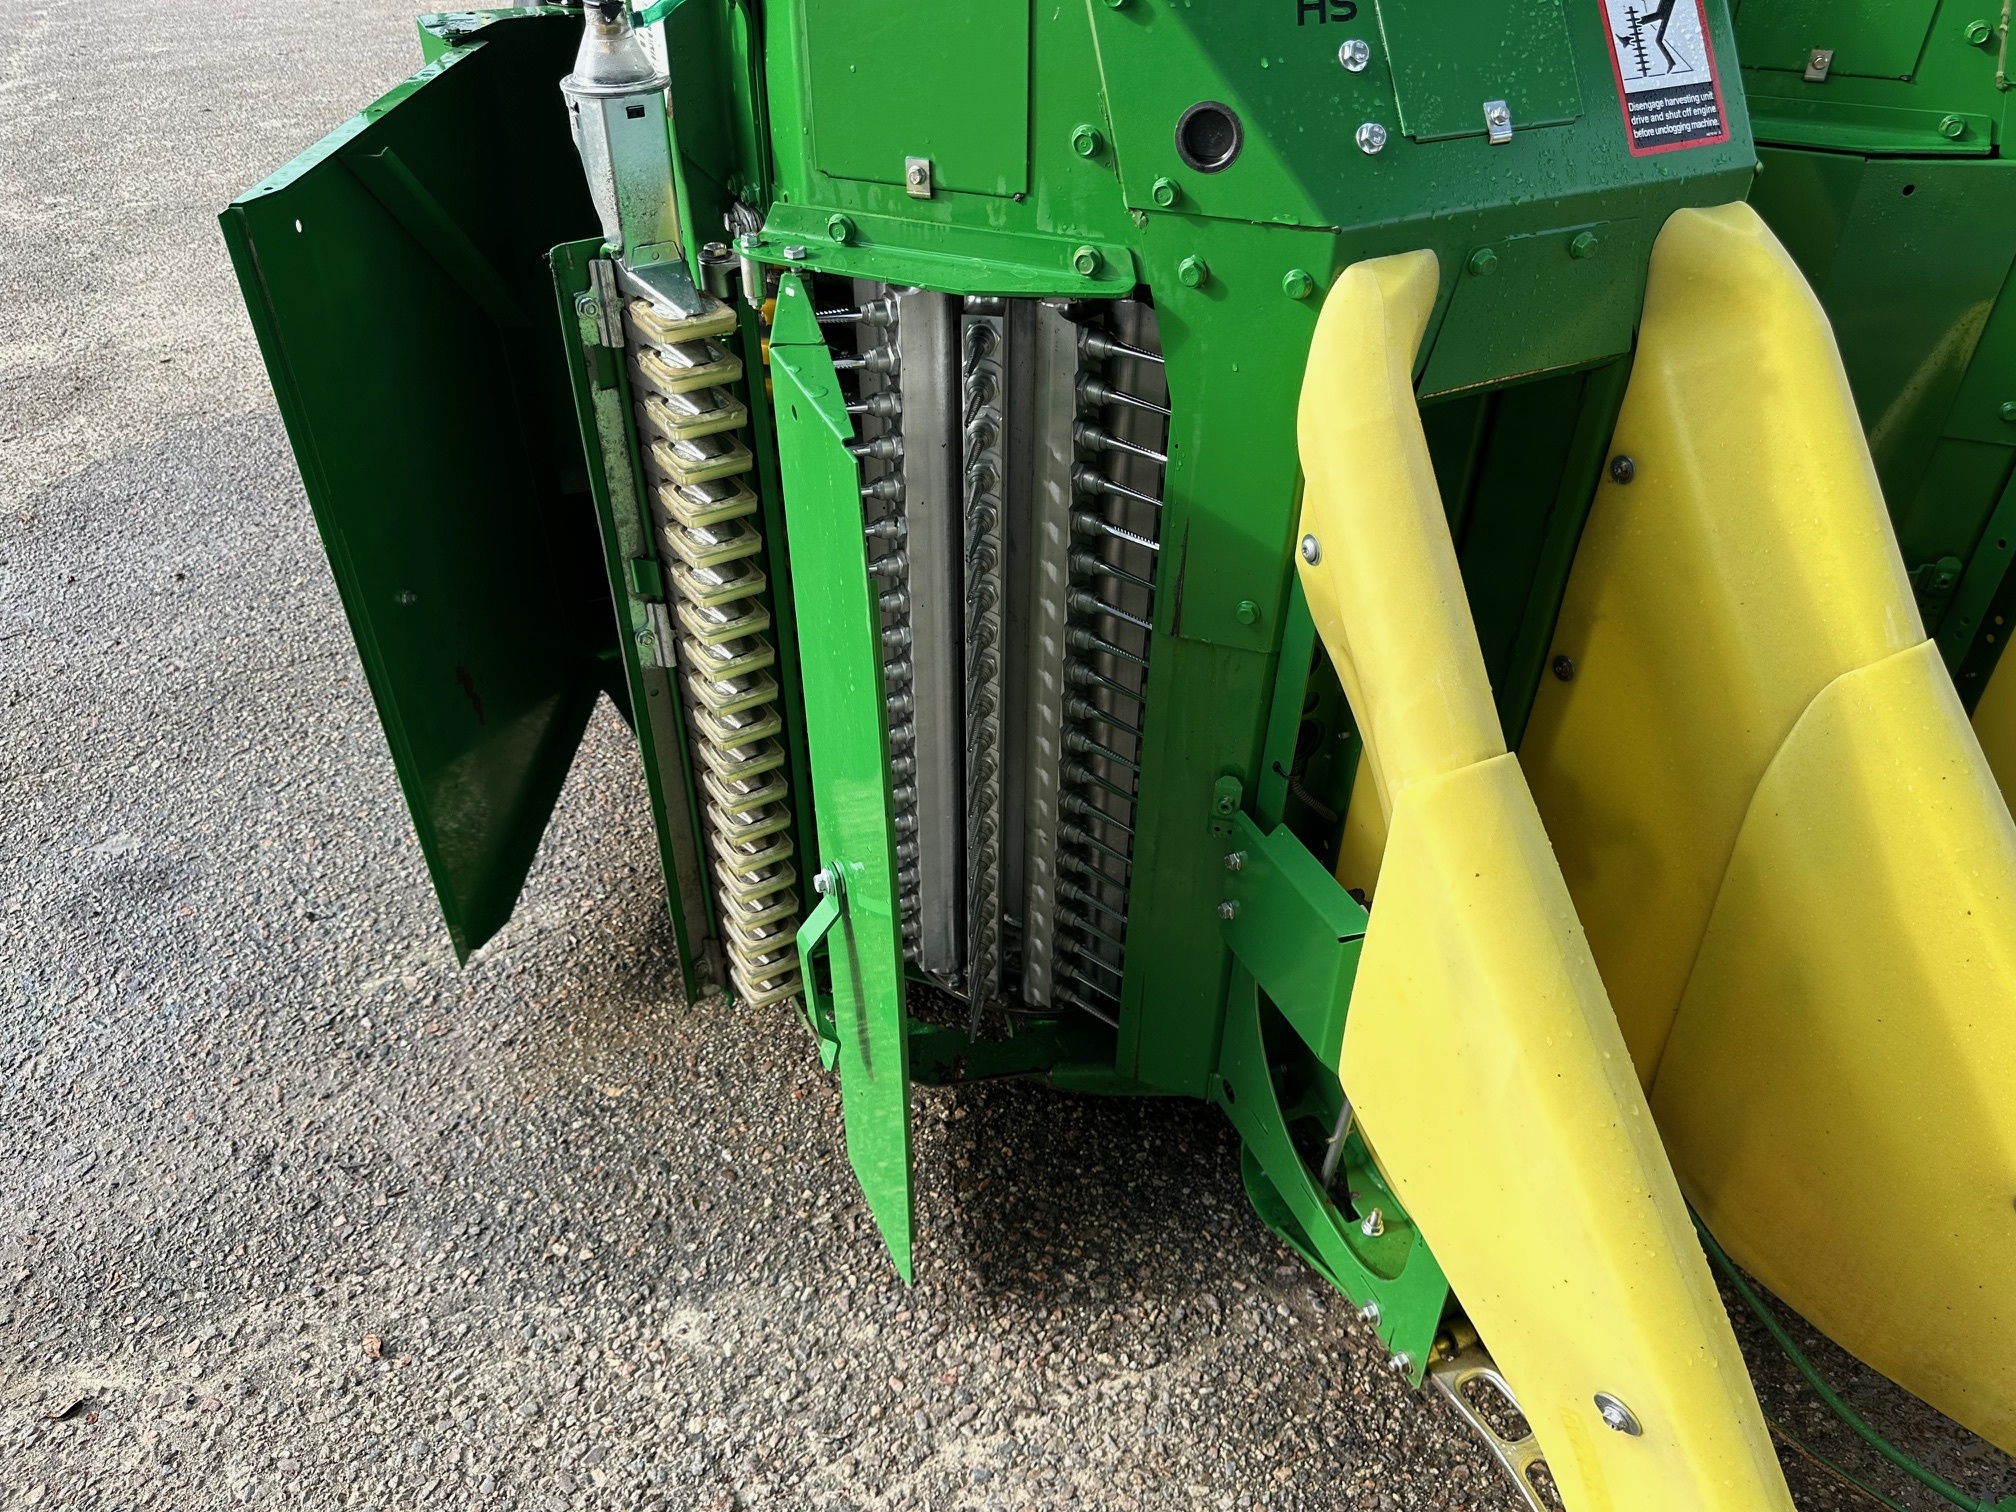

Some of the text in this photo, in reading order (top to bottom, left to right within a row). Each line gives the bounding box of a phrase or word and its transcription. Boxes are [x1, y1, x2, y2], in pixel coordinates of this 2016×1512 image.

[1628, 91, 1714, 112] Disengage harvesting unit
[1631, 104, 1717, 126] drive and shut off engine
[1633, 127, 1655, 139] before
[1655, 122, 1691, 135] unclogging
[1691, 118, 1719, 129] machine.
